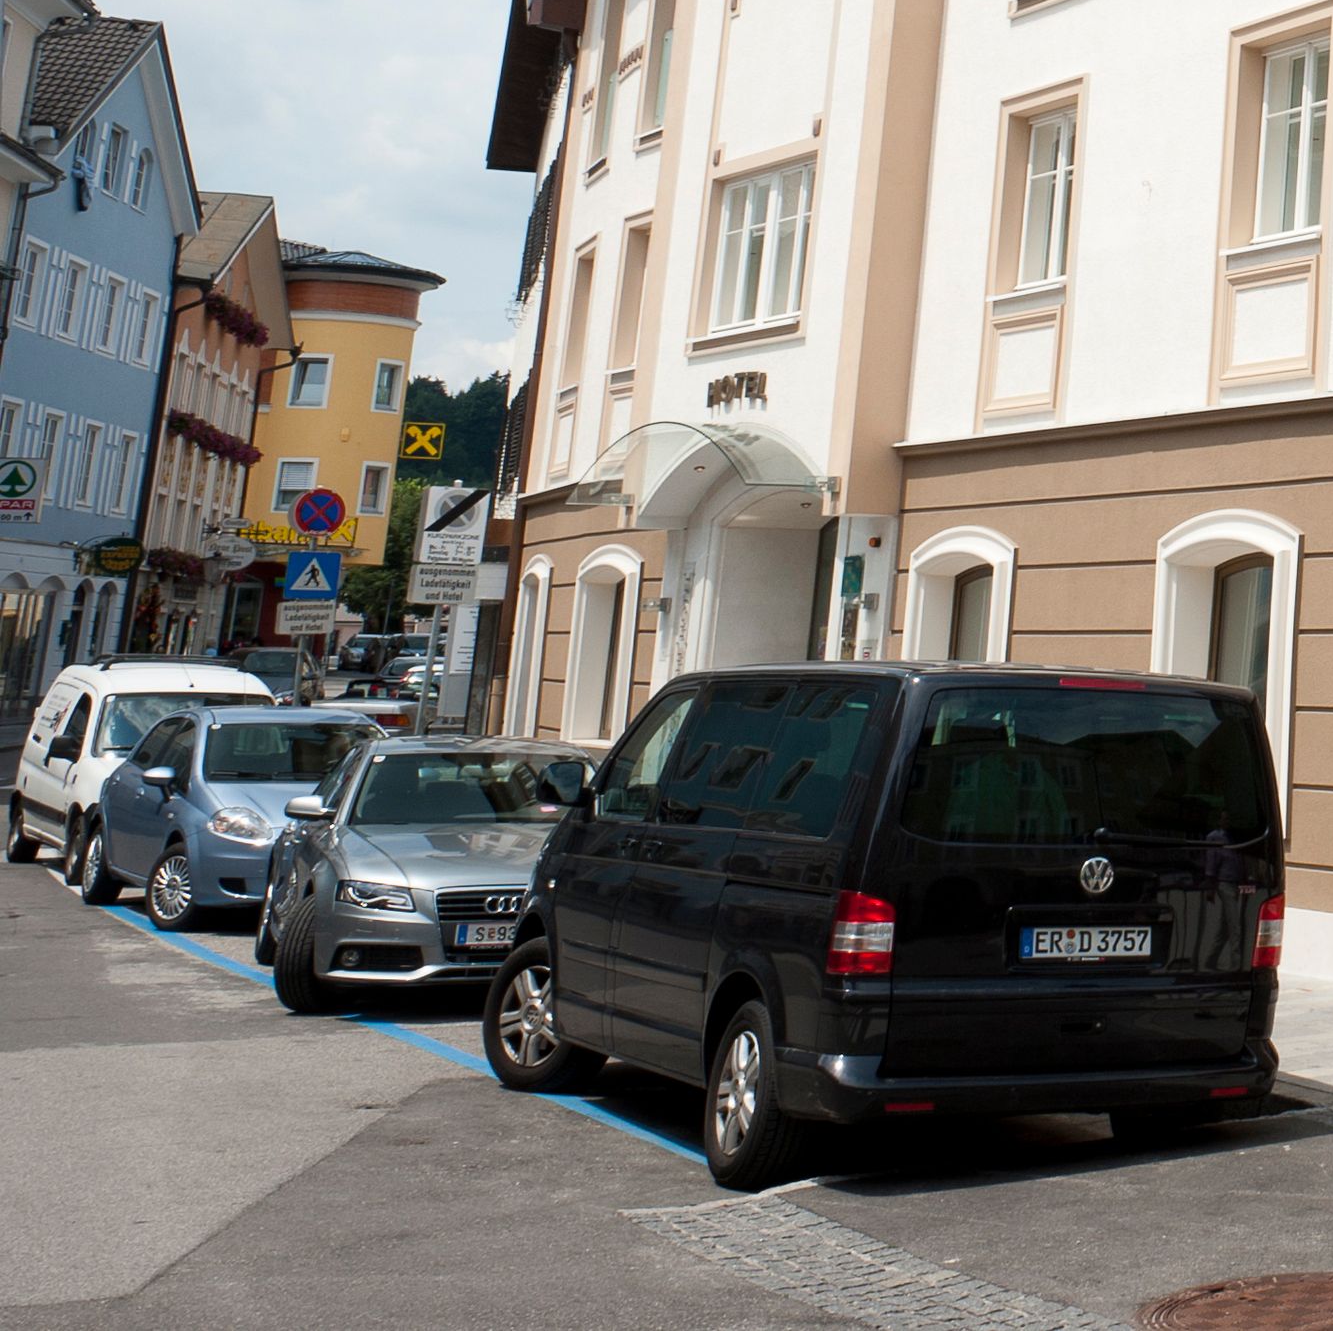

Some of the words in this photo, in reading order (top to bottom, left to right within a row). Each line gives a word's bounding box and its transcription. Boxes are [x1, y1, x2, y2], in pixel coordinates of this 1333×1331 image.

[706, 371, 768, 408] HOTEL
[0, 500, 33, 509] PAR
[419, 568, 476, 577] ausgenommen
[442, 591, 464, 601] Hotel
[475, 926, 485, 942] S
[496, 925, 516, 941] 93
[1034, 931, 1064, 954] ER
[1078, 930, 1092, 953] D
[1097, 929, 1150, 952] 3757
